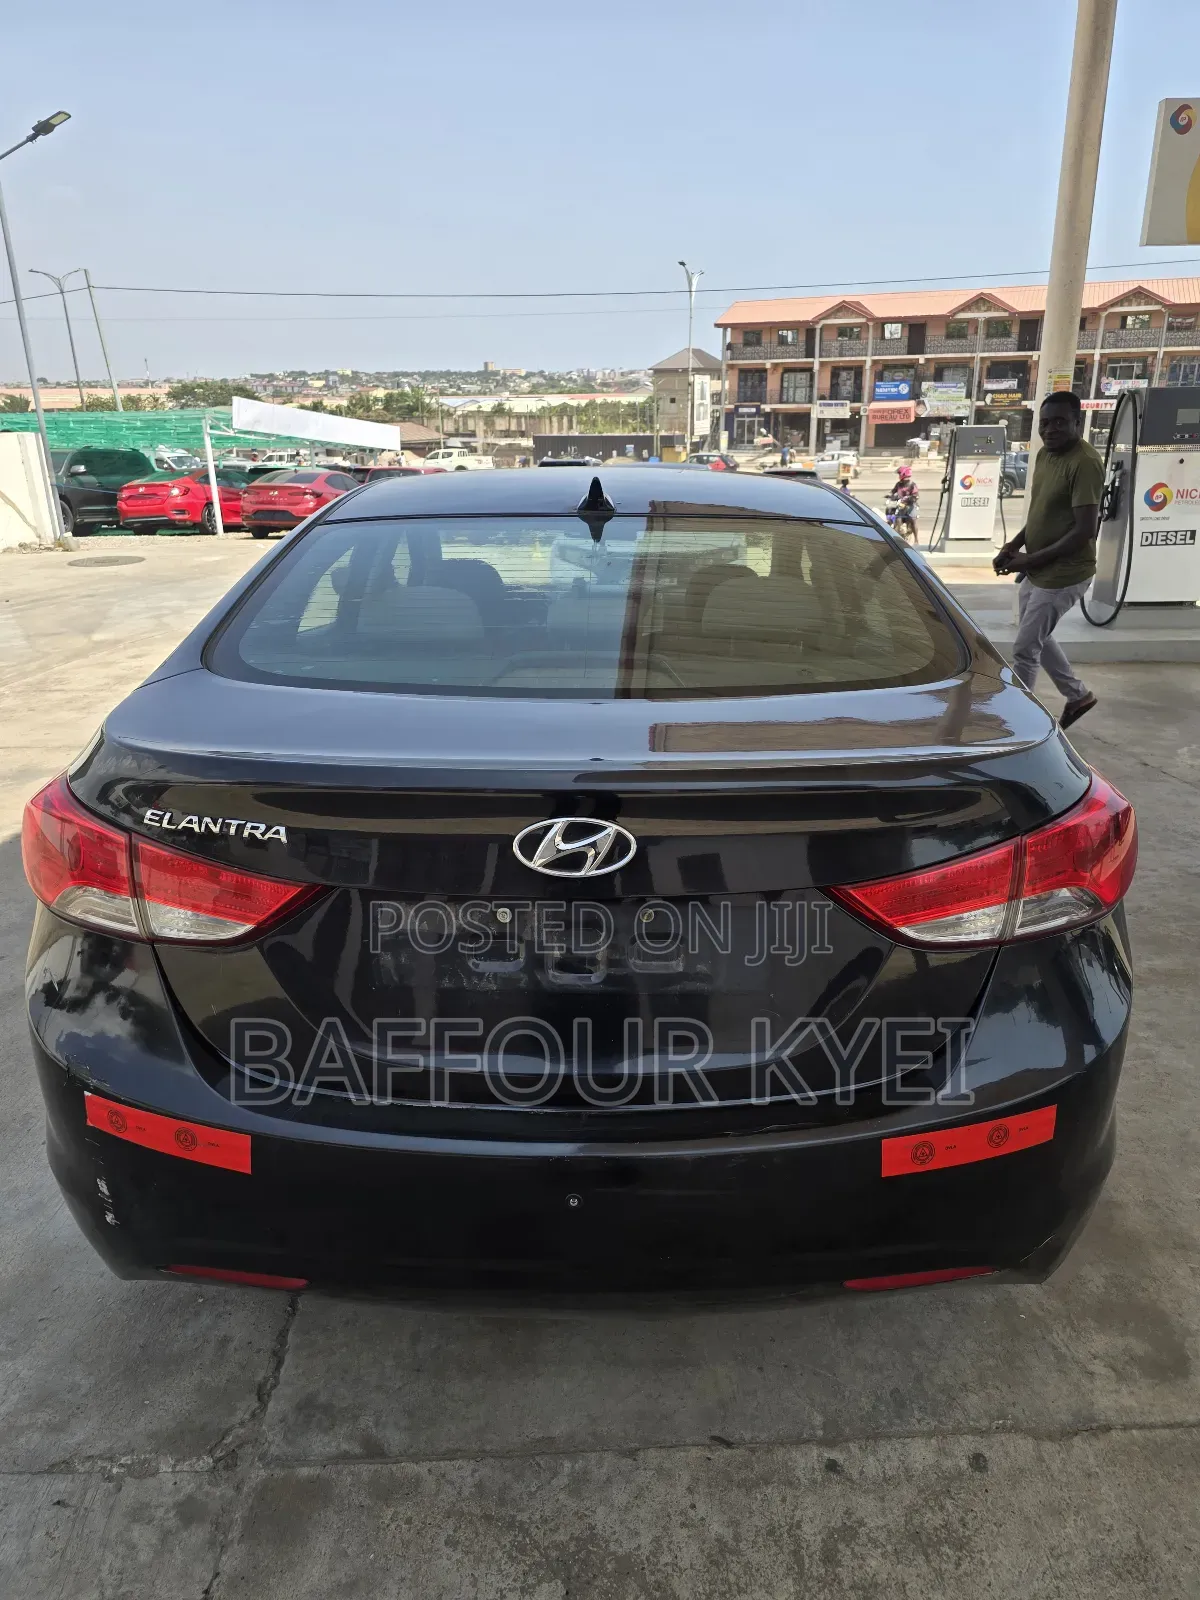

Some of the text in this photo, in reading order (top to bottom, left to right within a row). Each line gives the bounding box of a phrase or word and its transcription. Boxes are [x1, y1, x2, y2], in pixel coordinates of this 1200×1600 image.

[1175, 488, 1200, 499] NIC
[961, 497, 989, 507] DIESEL
[1141, 530, 1195, 546] DIESEL
[143, 808, 289, 844] ELANTRA
